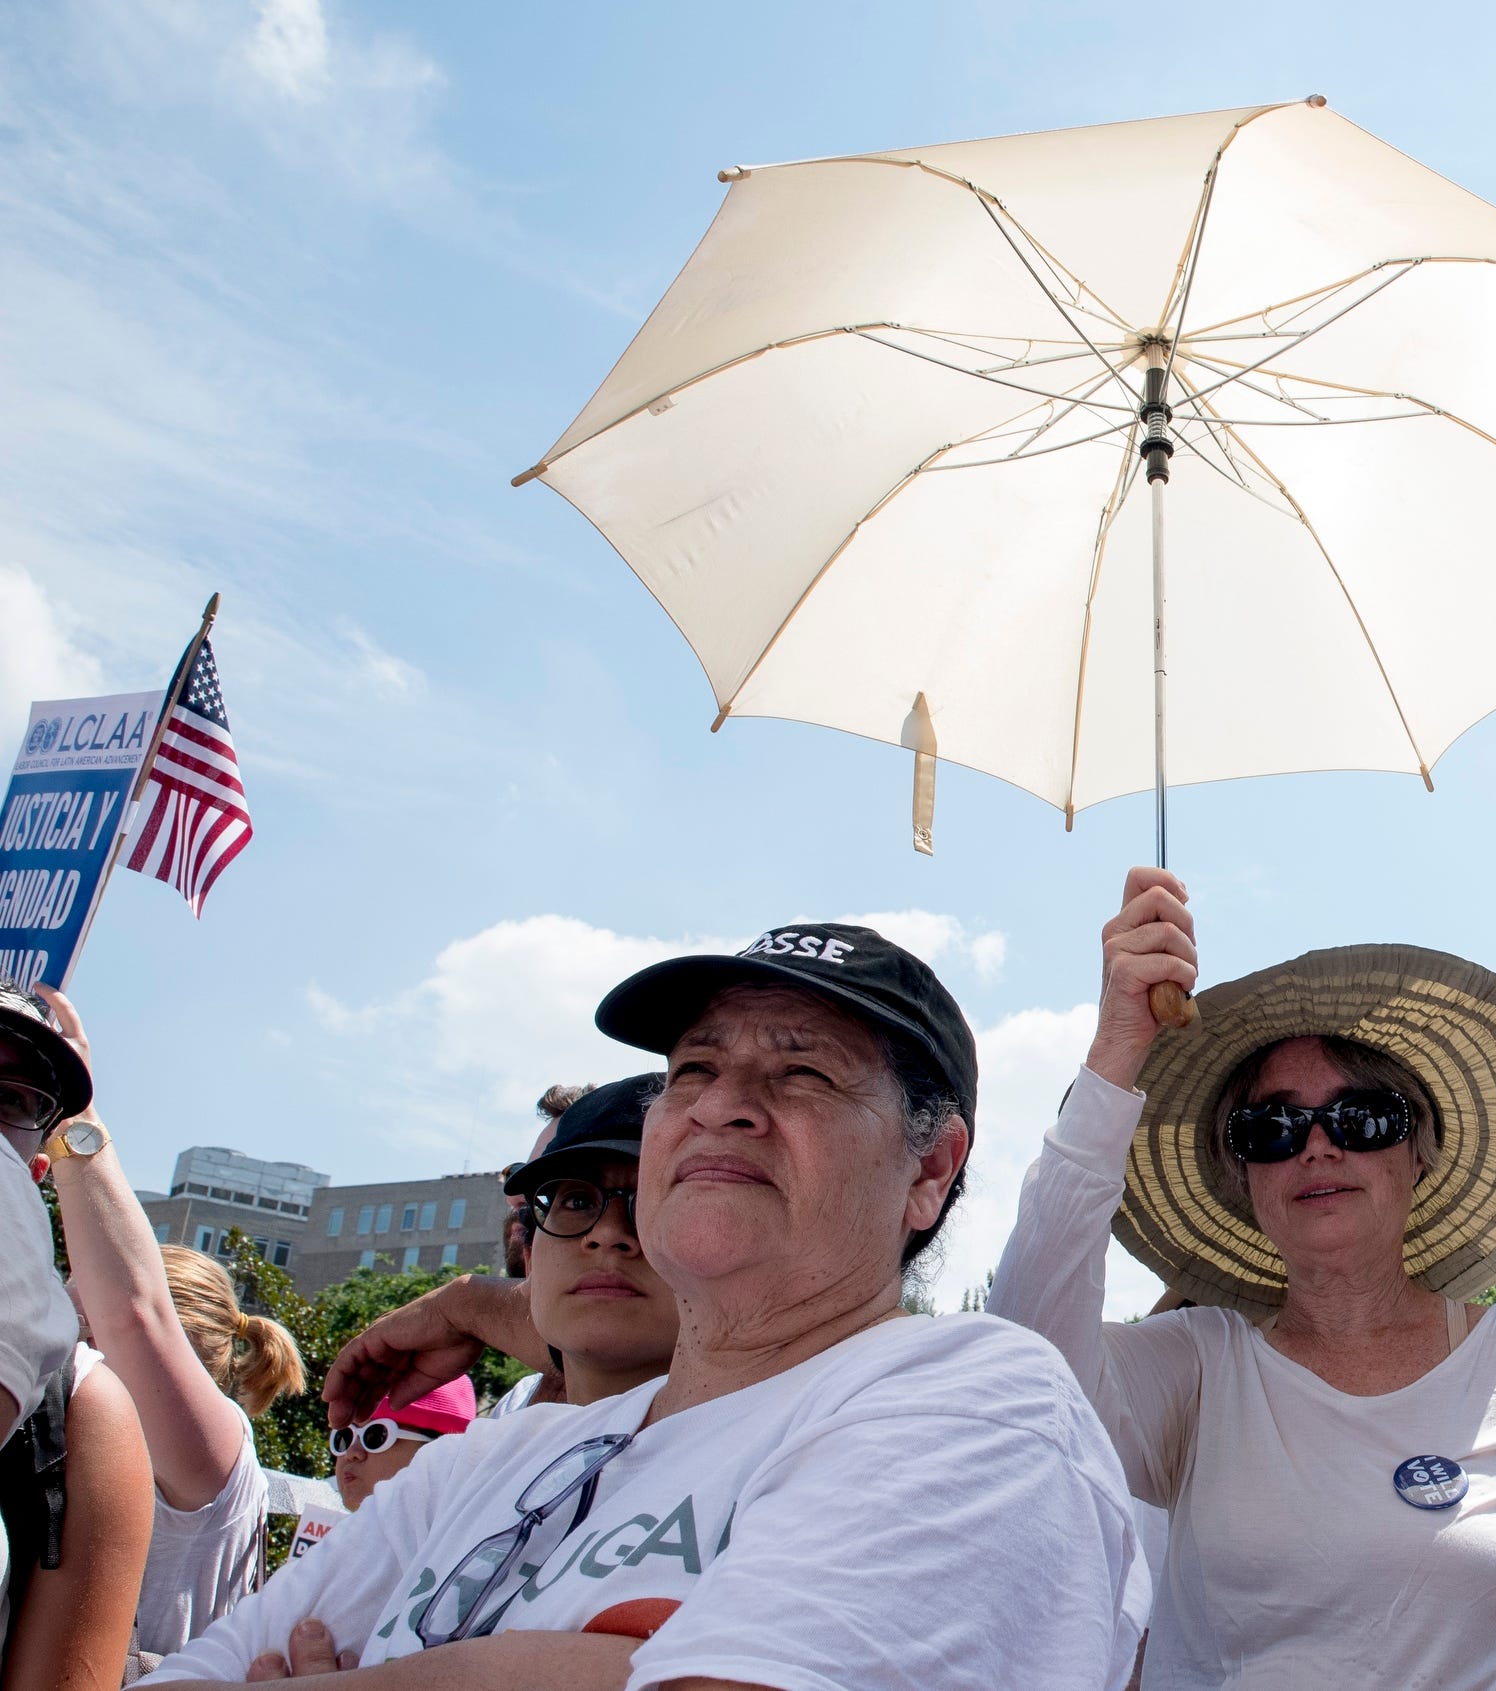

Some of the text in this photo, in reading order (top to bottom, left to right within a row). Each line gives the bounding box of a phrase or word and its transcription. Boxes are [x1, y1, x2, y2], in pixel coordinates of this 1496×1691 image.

[57, 711, 149, 752] LCLAA
[75, 756, 102, 766] AMERICAN
[88, 791, 119, 850] Y
